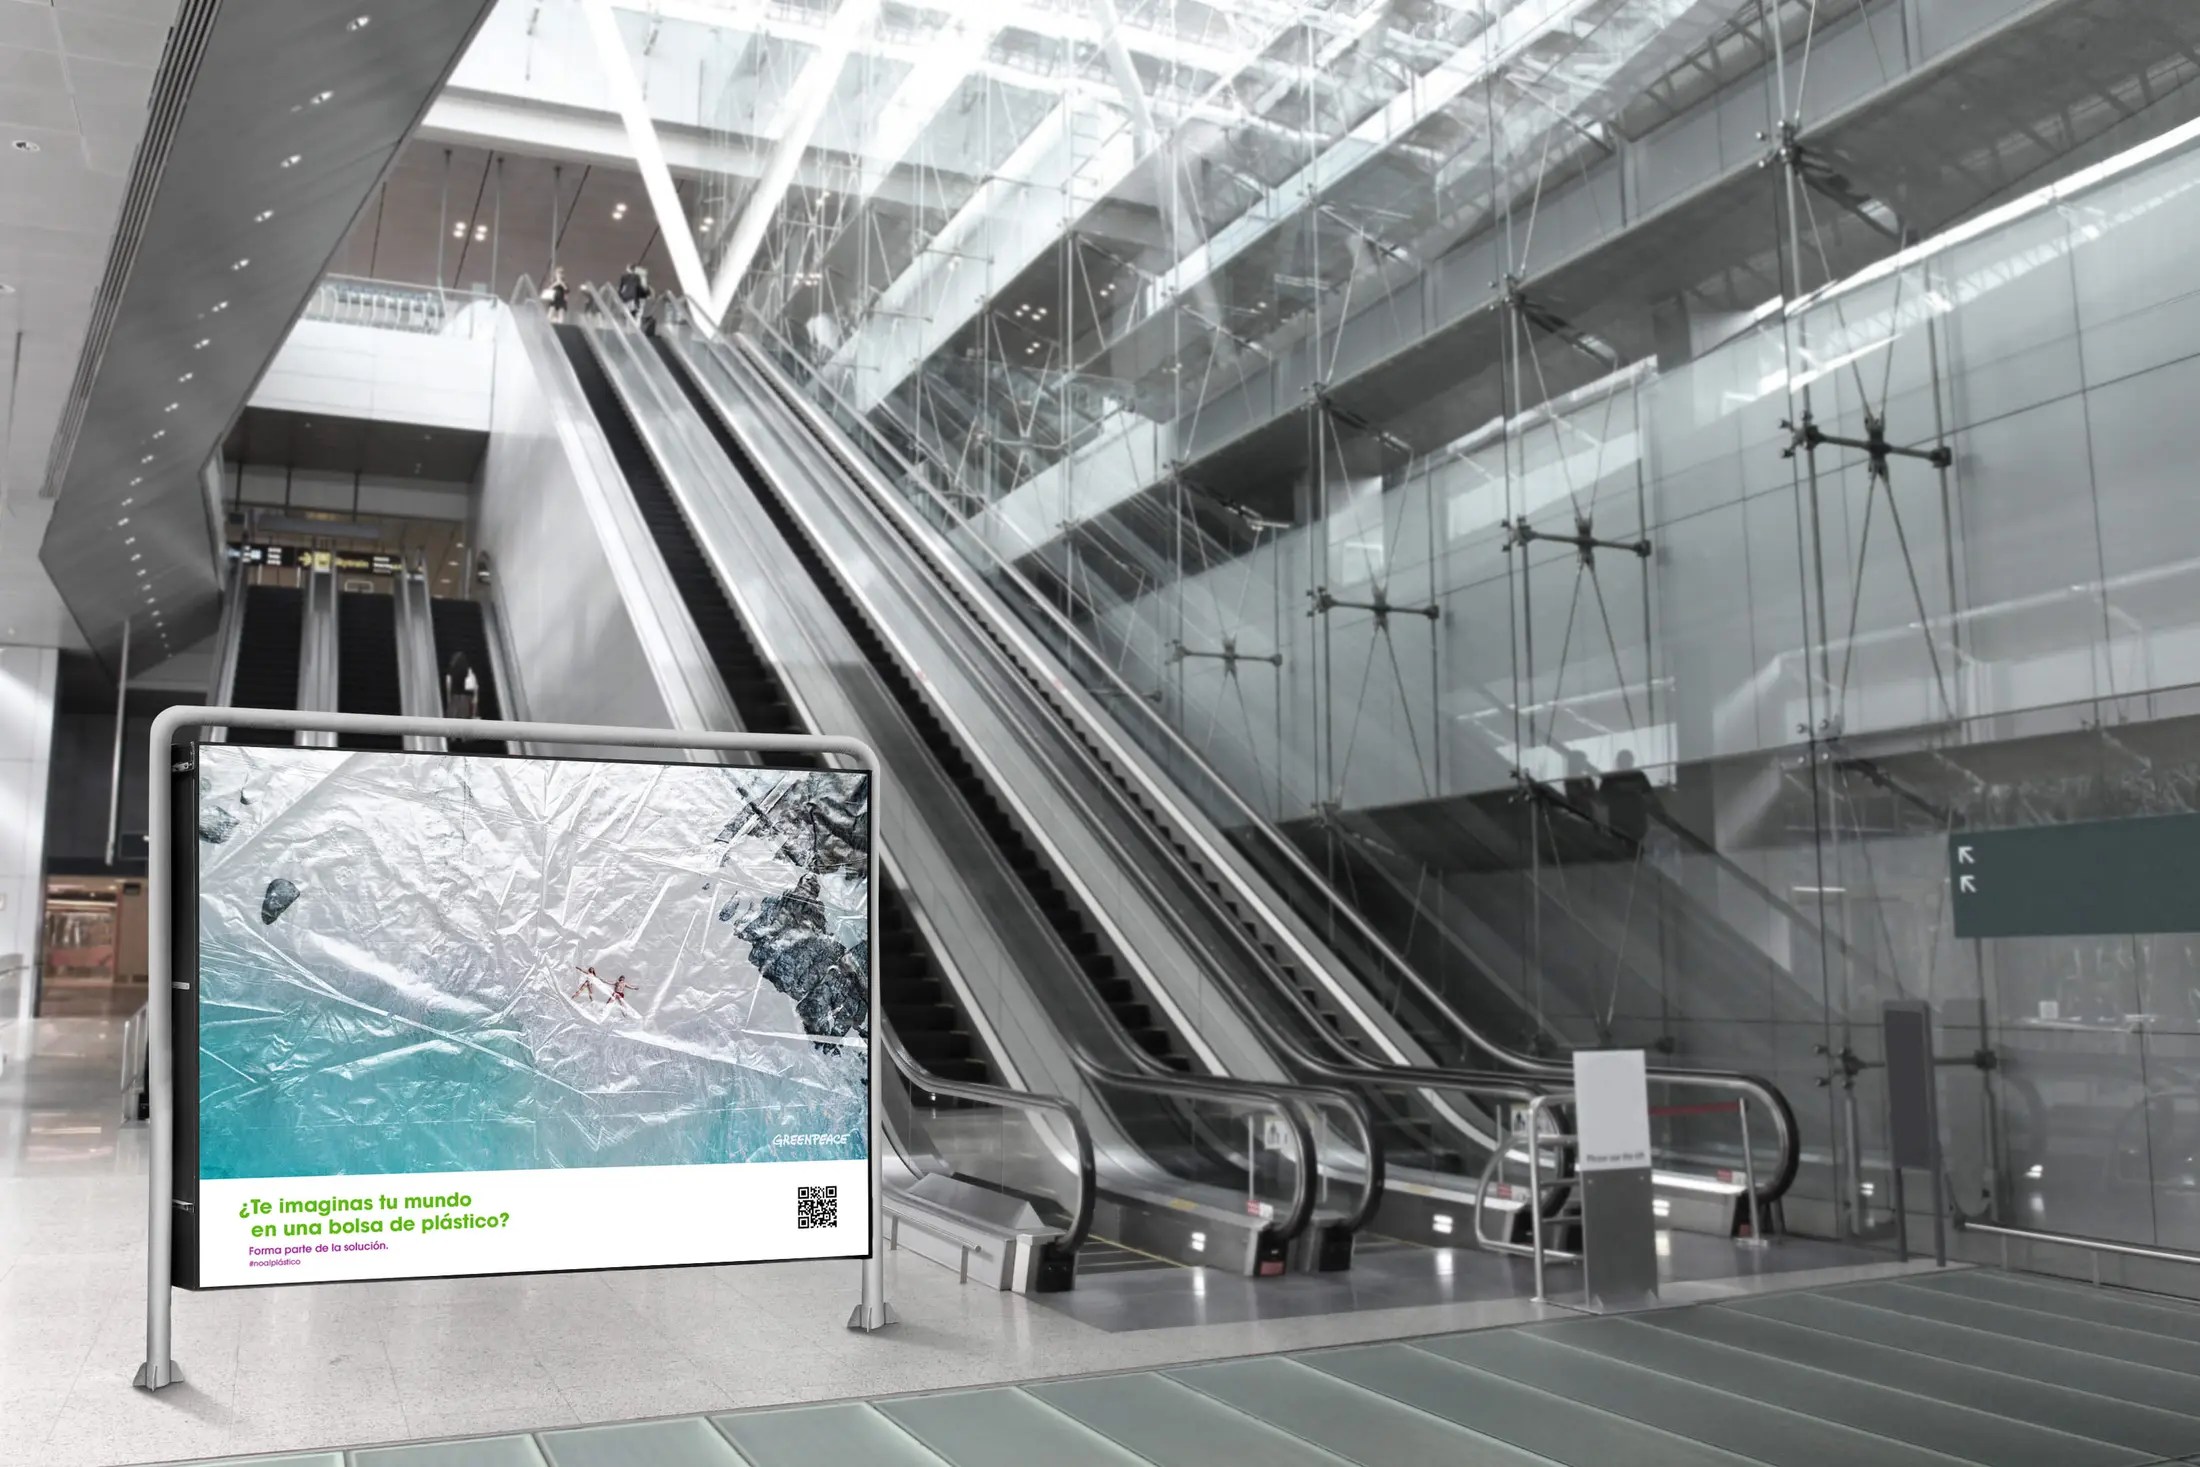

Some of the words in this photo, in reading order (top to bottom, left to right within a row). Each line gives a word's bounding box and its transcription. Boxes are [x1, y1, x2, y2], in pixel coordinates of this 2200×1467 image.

[773, 1133, 850, 1147] GREENPEACE
[239, 1198, 273, 1219] ¿Te
[279, 1195, 373, 1217] imaginas
[379, 1194, 398, 1210] tu
[404, 1191, 472, 1209] mundo
[251, 1223, 277, 1238] en
[283, 1222, 322, 1237] una
[329, 1217, 384, 1236] bolsa
[390, 1215, 416, 1232] de
[421, 1212, 511, 1235] plástico?
[249, 1246, 282, 1256] Forma
[284, 1244, 312, 1256] parte
[315, 1243, 329, 1253] de
[331, 1243, 341, 1252] la
[344, 1240, 389, 1252] solución.
